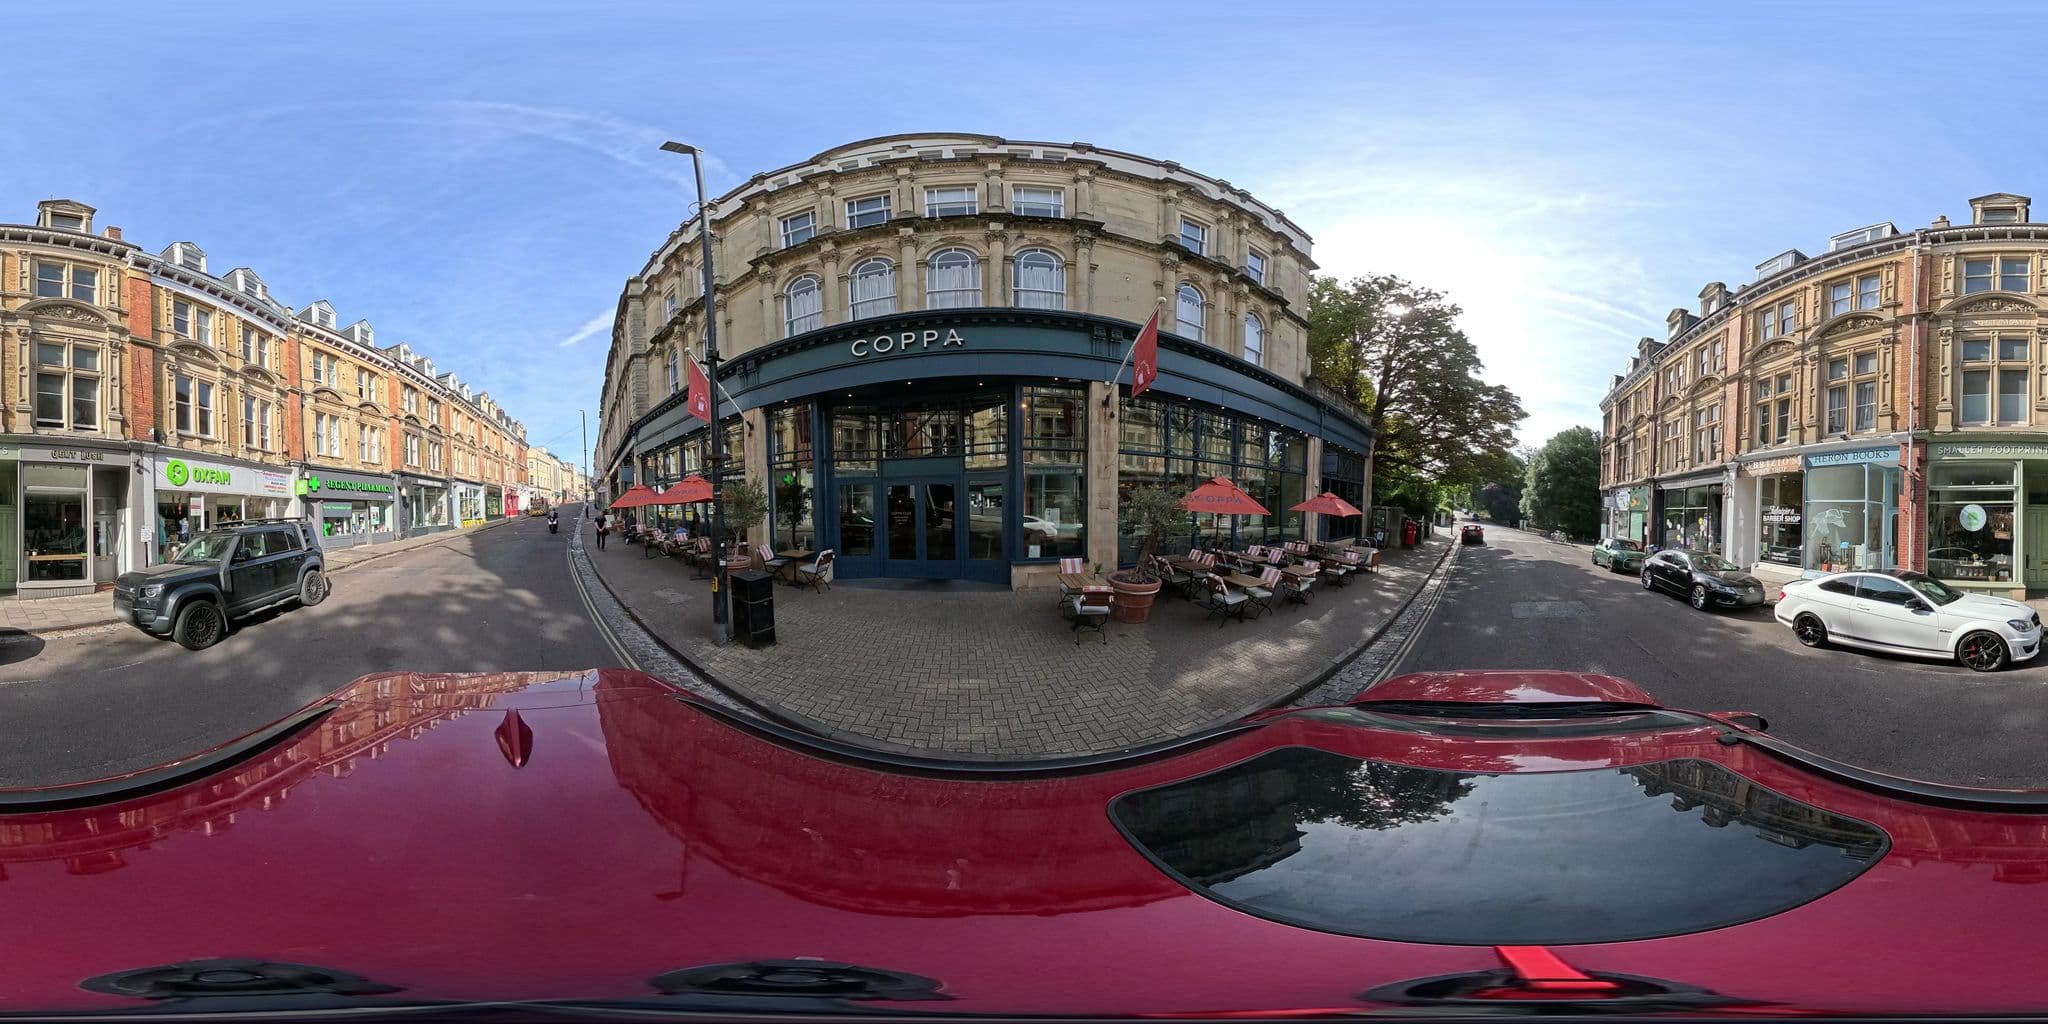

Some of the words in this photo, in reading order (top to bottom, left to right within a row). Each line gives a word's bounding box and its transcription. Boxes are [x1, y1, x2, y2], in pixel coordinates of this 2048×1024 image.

[851, 329, 964, 356] COPPA
[80, 450, 104, 460] LUSH
[1814, 453, 1848, 463] HERON
[1853, 449, 1890, 460] BOOKS
[1938, 446, 1983, 455] SMALLER
[192, 467, 231, 485] OXFAM
[326, 479, 355, 491] REGENT
[357, 482, 392, 493] PHARMACY
